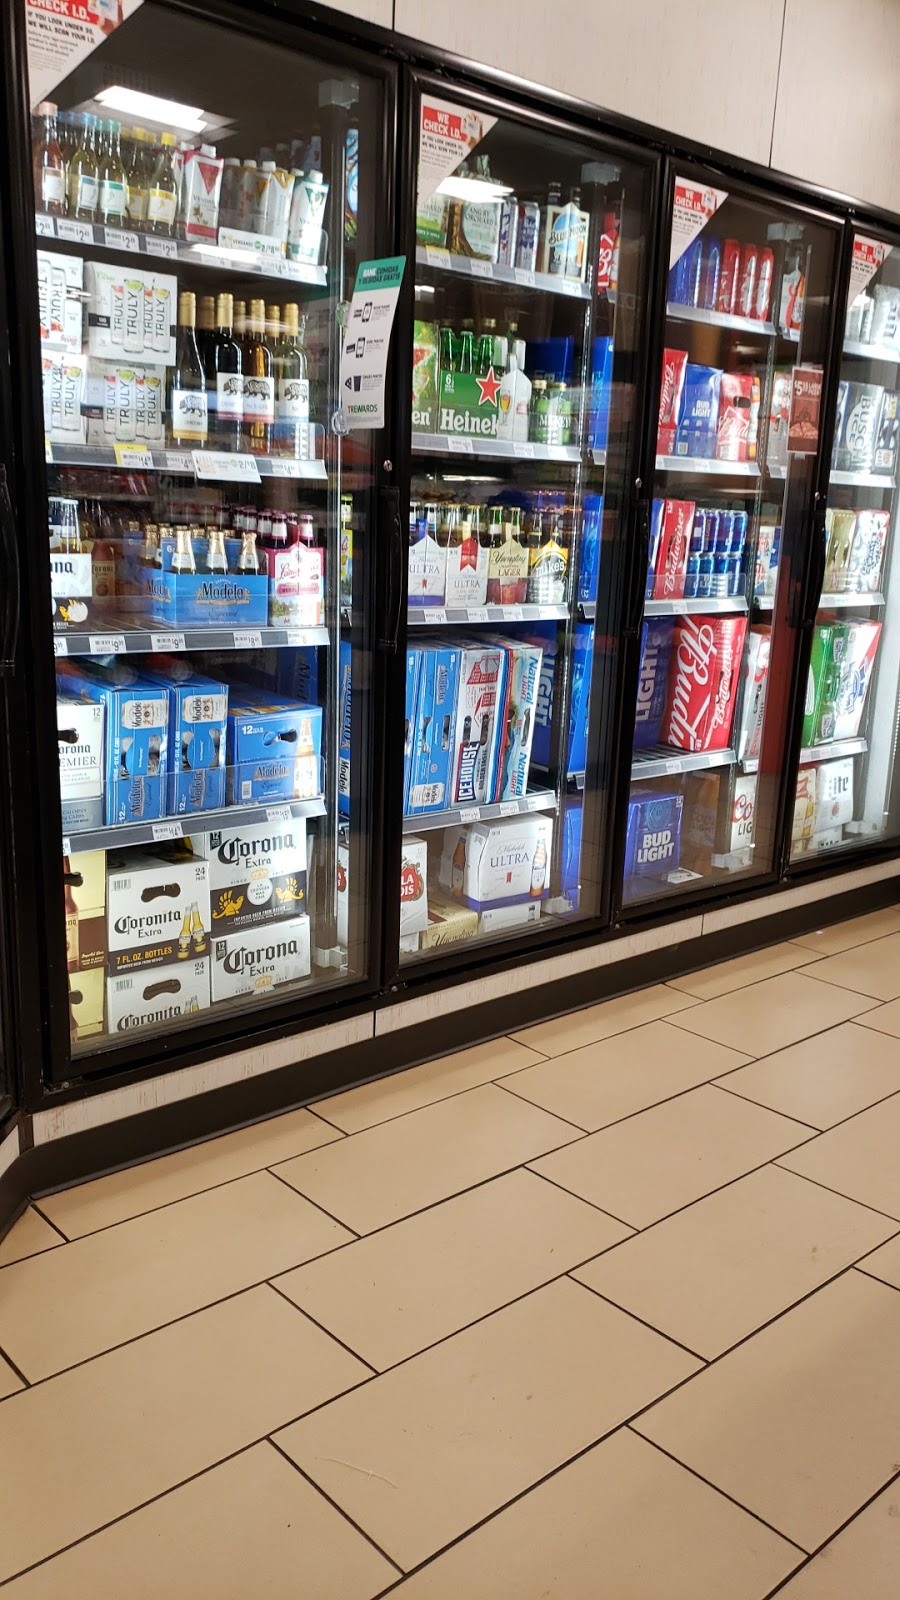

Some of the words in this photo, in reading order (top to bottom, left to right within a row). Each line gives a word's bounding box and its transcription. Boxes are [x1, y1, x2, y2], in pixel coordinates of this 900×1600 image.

[35, 12, 47, 21] YOU
[48, 16, 62, 26] LOOK
[64, 20, 84, 32] UNDER
[39, 23, 52, 32] WILL
[54, 27, 70, 36] SCAN
[72, 32, 86, 42] YOUR
[424, 119, 448, 136] CHECK
[437, 111, 450, 125] WE
[464, 214, 494, 226] ORCHARD
[470, 206, 490, 216] ANGRY
[569, 224, 587, 238] MOON
[51, 282, 62, 323] TRULY
[114, 294, 122, 331] TRULY
[127, 290, 138, 336] TRULY
[144, 299, 153, 334] TRULY
[156, 298, 165, 338] TRULY
[445, 374, 452, 384] 6
[52, 378, 62, 415] TRULY
[64, 376, 75, 416] TRULY
[106, 385, 116, 422] TRULY
[120, 380, 130, 426] TRULY
[136, 388, 145, 424] TRULY
[148, 387, 156, 427] TRULY
[696, 400, 710, 408] BUD
[692, 408, 711, 418] LIGHT
[850, 414, 860, 442] ICE
[852, 398, 872, 461] BUSCH
[491, 550, 526, 566] Yuengling
[663, 507, 685, 595] Budweiser
[410, 564, 440, 574] ULTRA
[498, 568, 521, 577] LAGER
[536, 558, 564, 578] mike's
[202, 582, 244, 600] Modelo
[454, 580, 480, 588] ULTRA
[438, 669, 448, 704] Modelo
[520, 674, 529, 702] LIGHT
[526, 656, 539, 706] Natural
[636, 648, 658, 721] LIGHT
[712, 646, 734, 729] Budweiser
[93, 708, 101, 717] 12
[132, 702, 142, 728] Modelo
[192, 696, 202, 722] Modelo
[242, 725, 253, 735] 12
[258, 764, 286, 778] Modelo
[339, 760, 350, 792] Modelo
[458, 741, 480, 801] ICEHOUSE
[508, 770, 518, 794] LIGHT
[515, 752, 528, 797] Natural
[131, 778, 142, 813] Modelo
[190, 770, 202, 804] Modelo
[430, 784, 440, 804] Modelo
[118, 810, 126, 820] 12
[179, 801, 186, 812] 12
[217, 833, 295, 866] Corona
[643, 830, 672, 847] BUD
[245, 858, 272, 870] Extra
[490, 852, 530, 868] ULTRA
[636, 842, 675, 864] LIGHT
[194, 867, 206, 876] 24
[114, 909, 182, 934] Coronita
[138, 928, 162, 939] Extra
[116, 956, 121, 964] 7
[122, 954, 132, 964] FL.
[132, 953, 144, 962] OZ.
[145, 946, 172, 960] BOTTLES
[218, 942, 226, 951] 12
[194, 962, 205, 972] 24
[223, 940, 299, 976] Corona
[250, 964, 275, 977] Extra
[116, 1005, 182, 1032] Coronita
